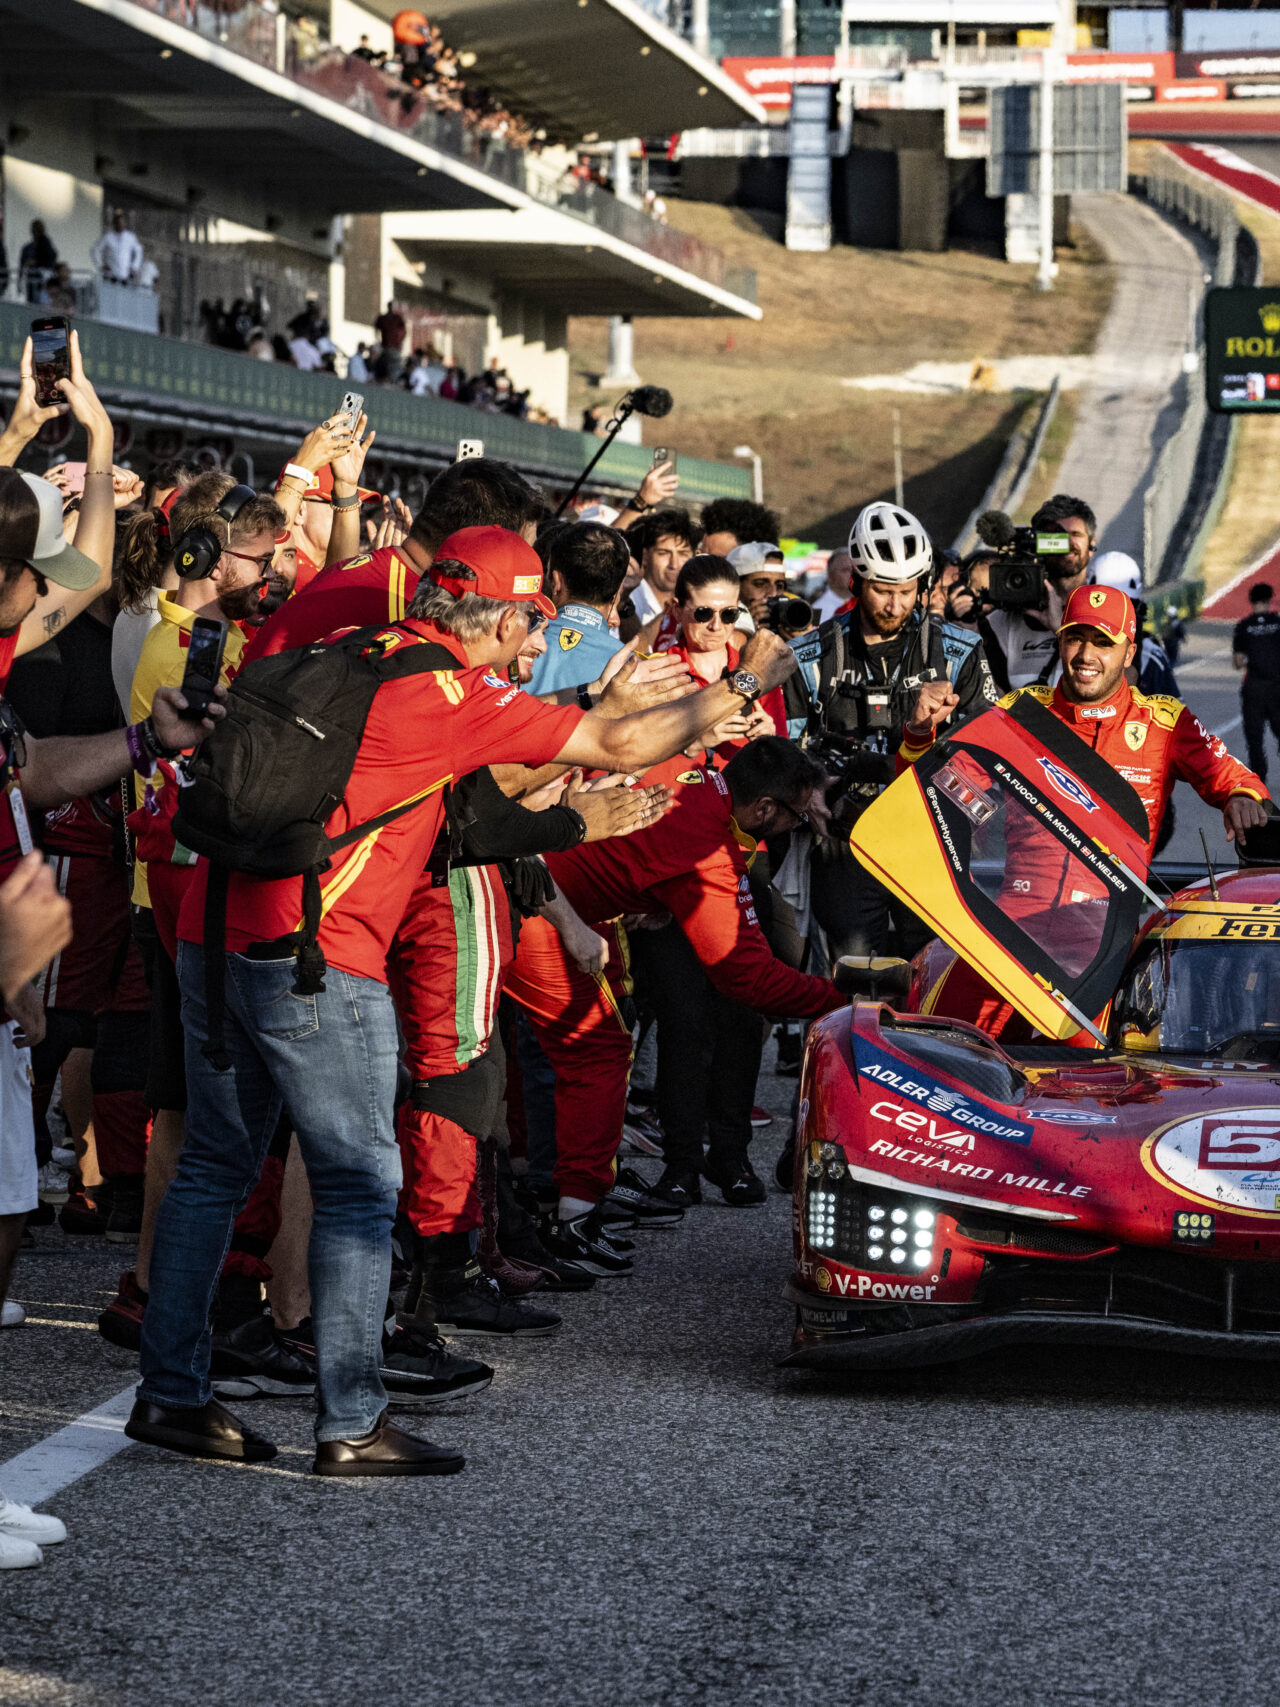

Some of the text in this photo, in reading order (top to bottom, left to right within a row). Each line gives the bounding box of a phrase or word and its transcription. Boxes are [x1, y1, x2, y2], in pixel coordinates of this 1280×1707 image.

[926, 786, 963, 872] @FerrariHypercar
[1002, 771, 1128, 892] A. FUOCO M. MOLINA N. NIELSEN
[1012, 879, 1031, 893] 50
[860, 1064, 1025, 1139] ADLER GROUP
[868, 1138, 1093, 1198] RICHARD MILLE
[907, 1134, 971, 1157] LOGISTICS
[834, 1273, 937, 1300] V-Power
